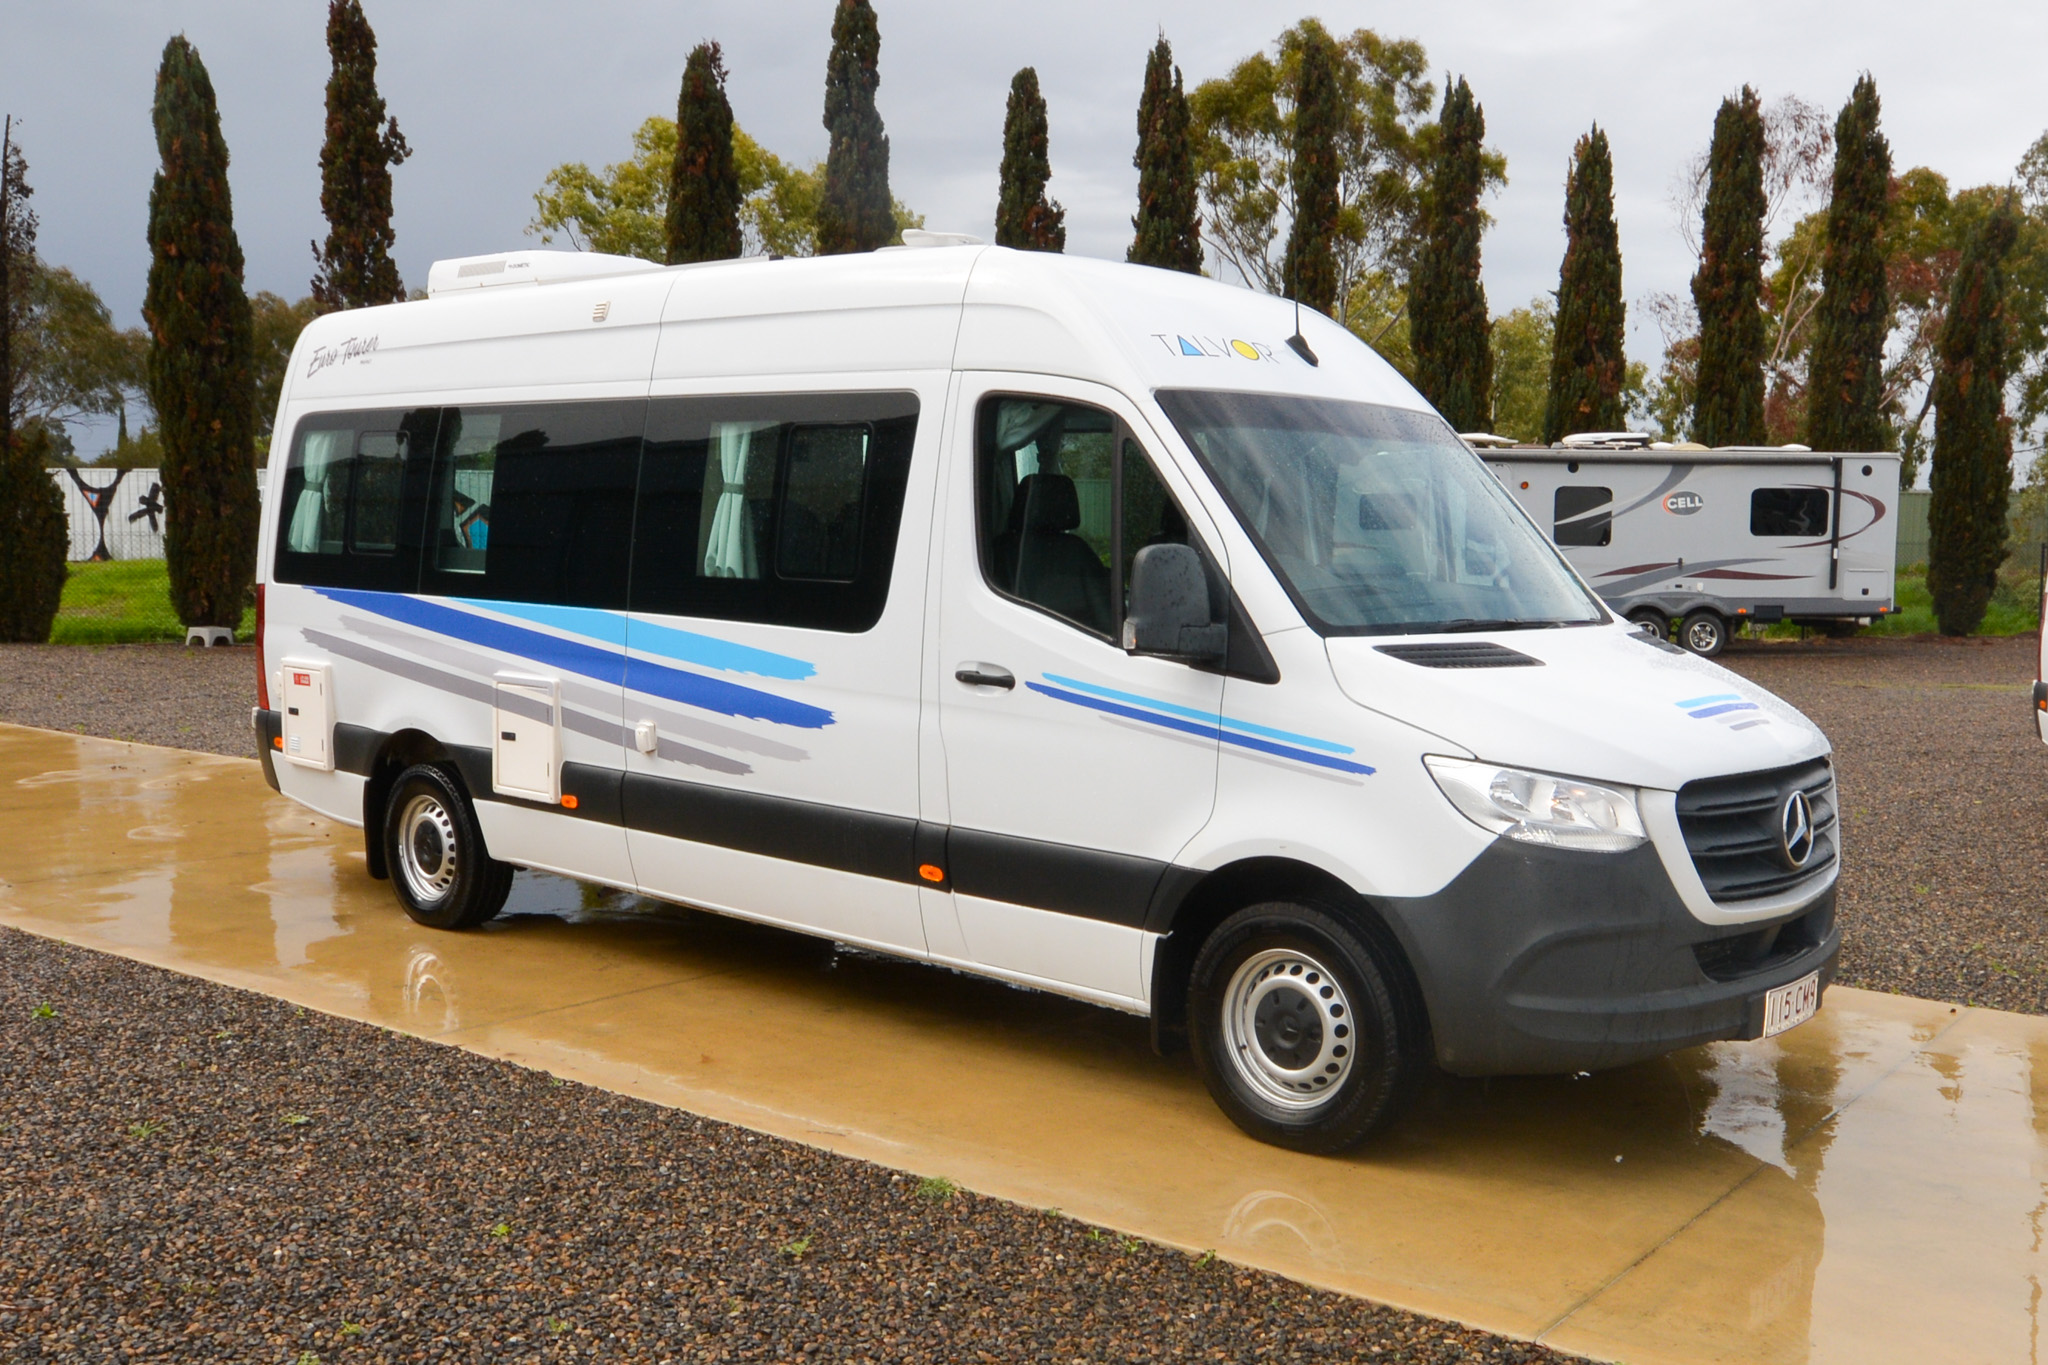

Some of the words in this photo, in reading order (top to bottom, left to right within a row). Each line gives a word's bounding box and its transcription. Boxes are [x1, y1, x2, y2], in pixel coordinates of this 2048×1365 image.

[307, 345, 338, 378] Euro
[340, 334, 379, 365] Tourer
[1150, 334, 1280, 364] TALVOR
[1667, 496, 1703, 509] CELL
